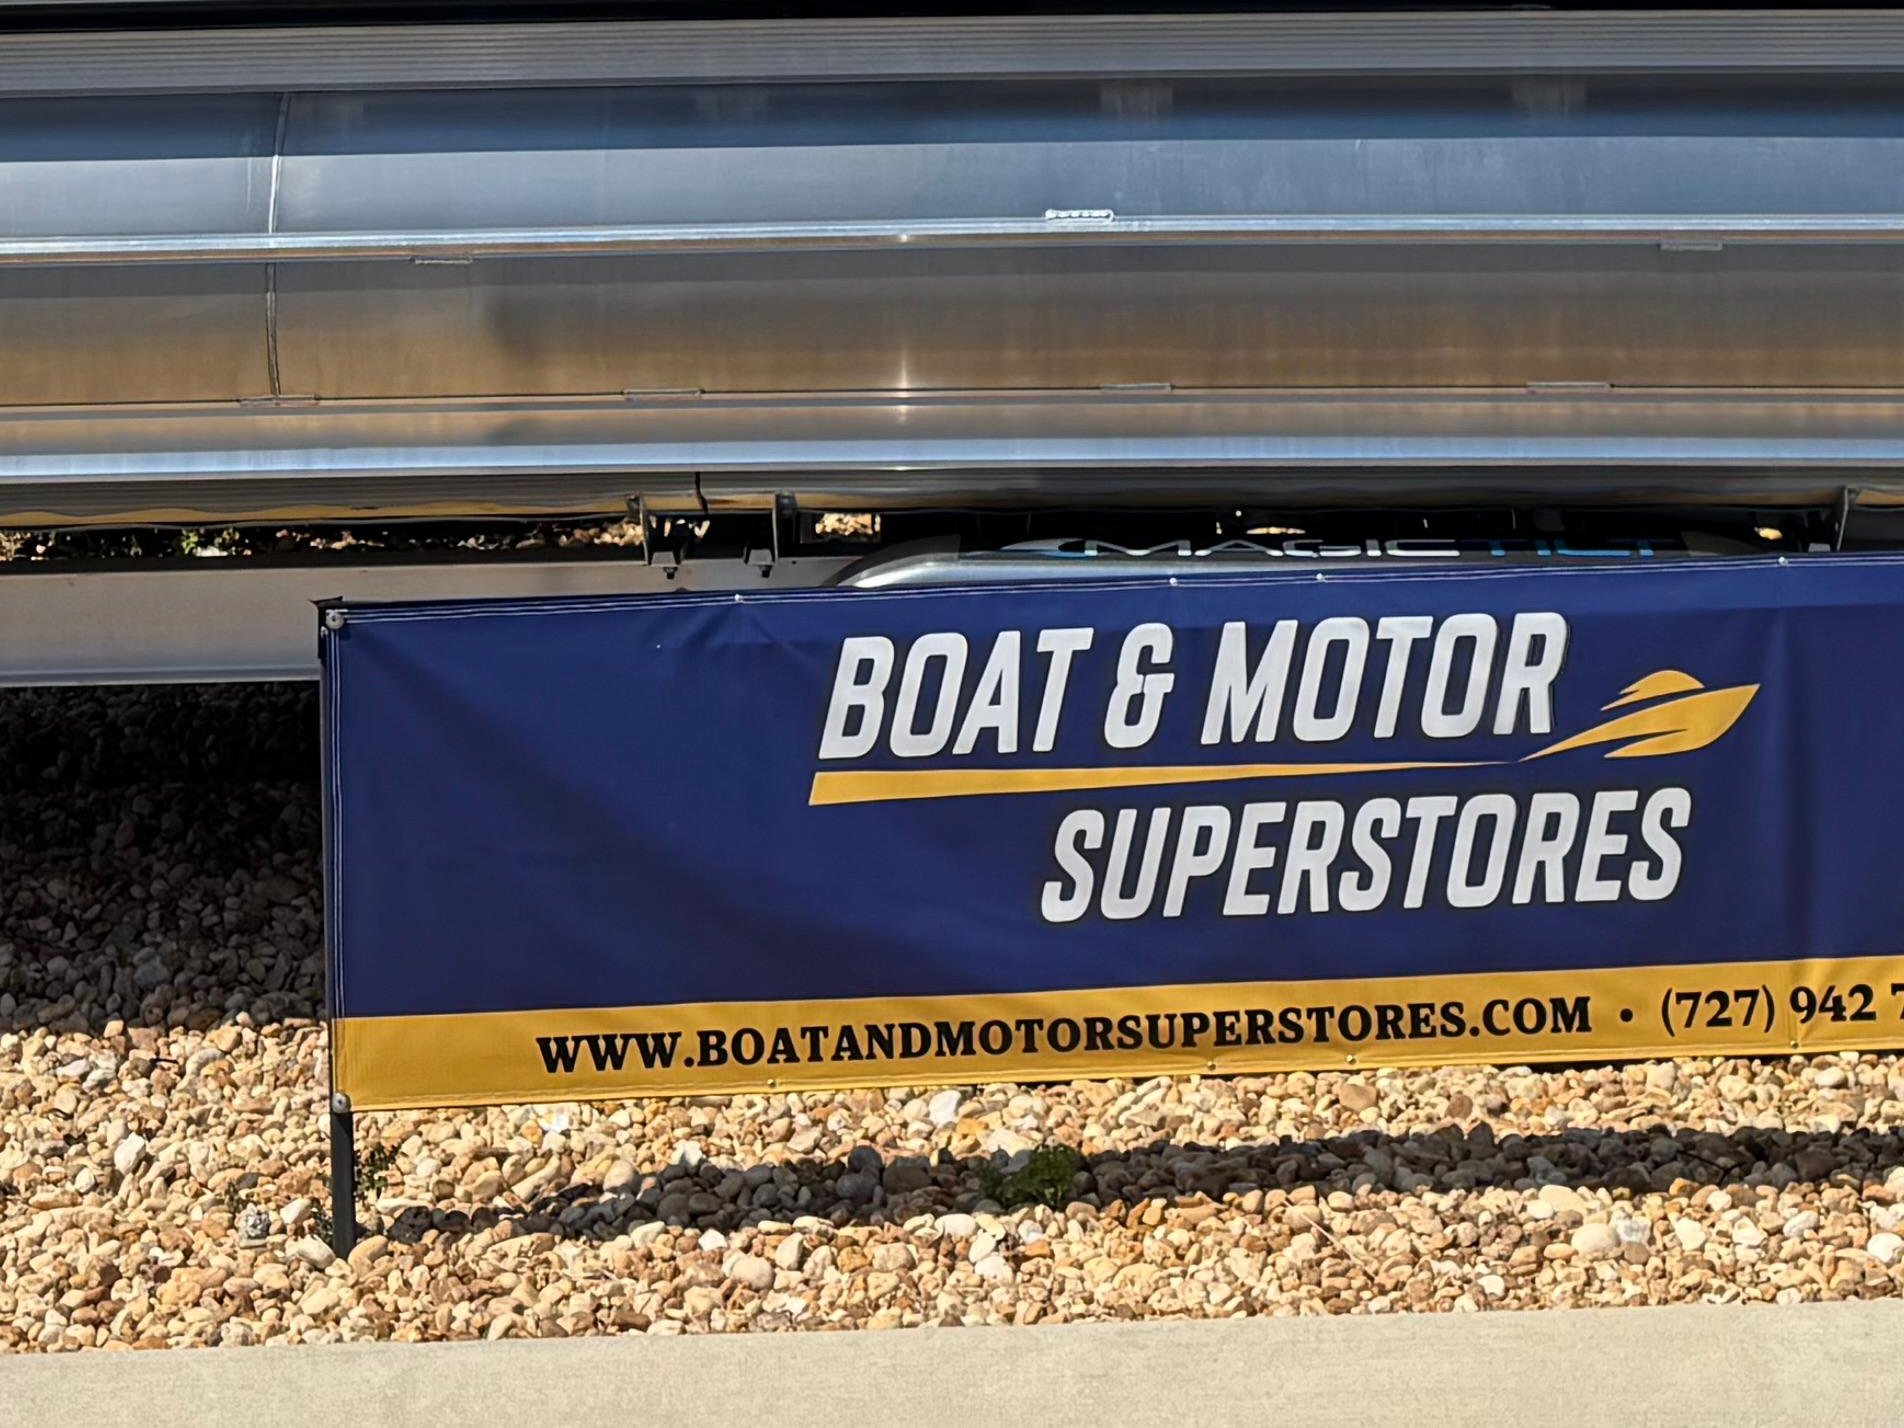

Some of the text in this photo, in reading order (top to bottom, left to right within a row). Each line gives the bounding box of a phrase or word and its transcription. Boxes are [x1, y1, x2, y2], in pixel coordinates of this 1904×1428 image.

[818, 612, 1569, 760] BOAT & MOTOR
[1040, 787, 1692, 924] SUPERSTORES
[536, 995, 1593, 1074] WWW.BOATANDMOTORSUPERSTORES.COM
[1659, 984, 1776, 1037] (727)
[1790, 982, 1878, 1025] 942
